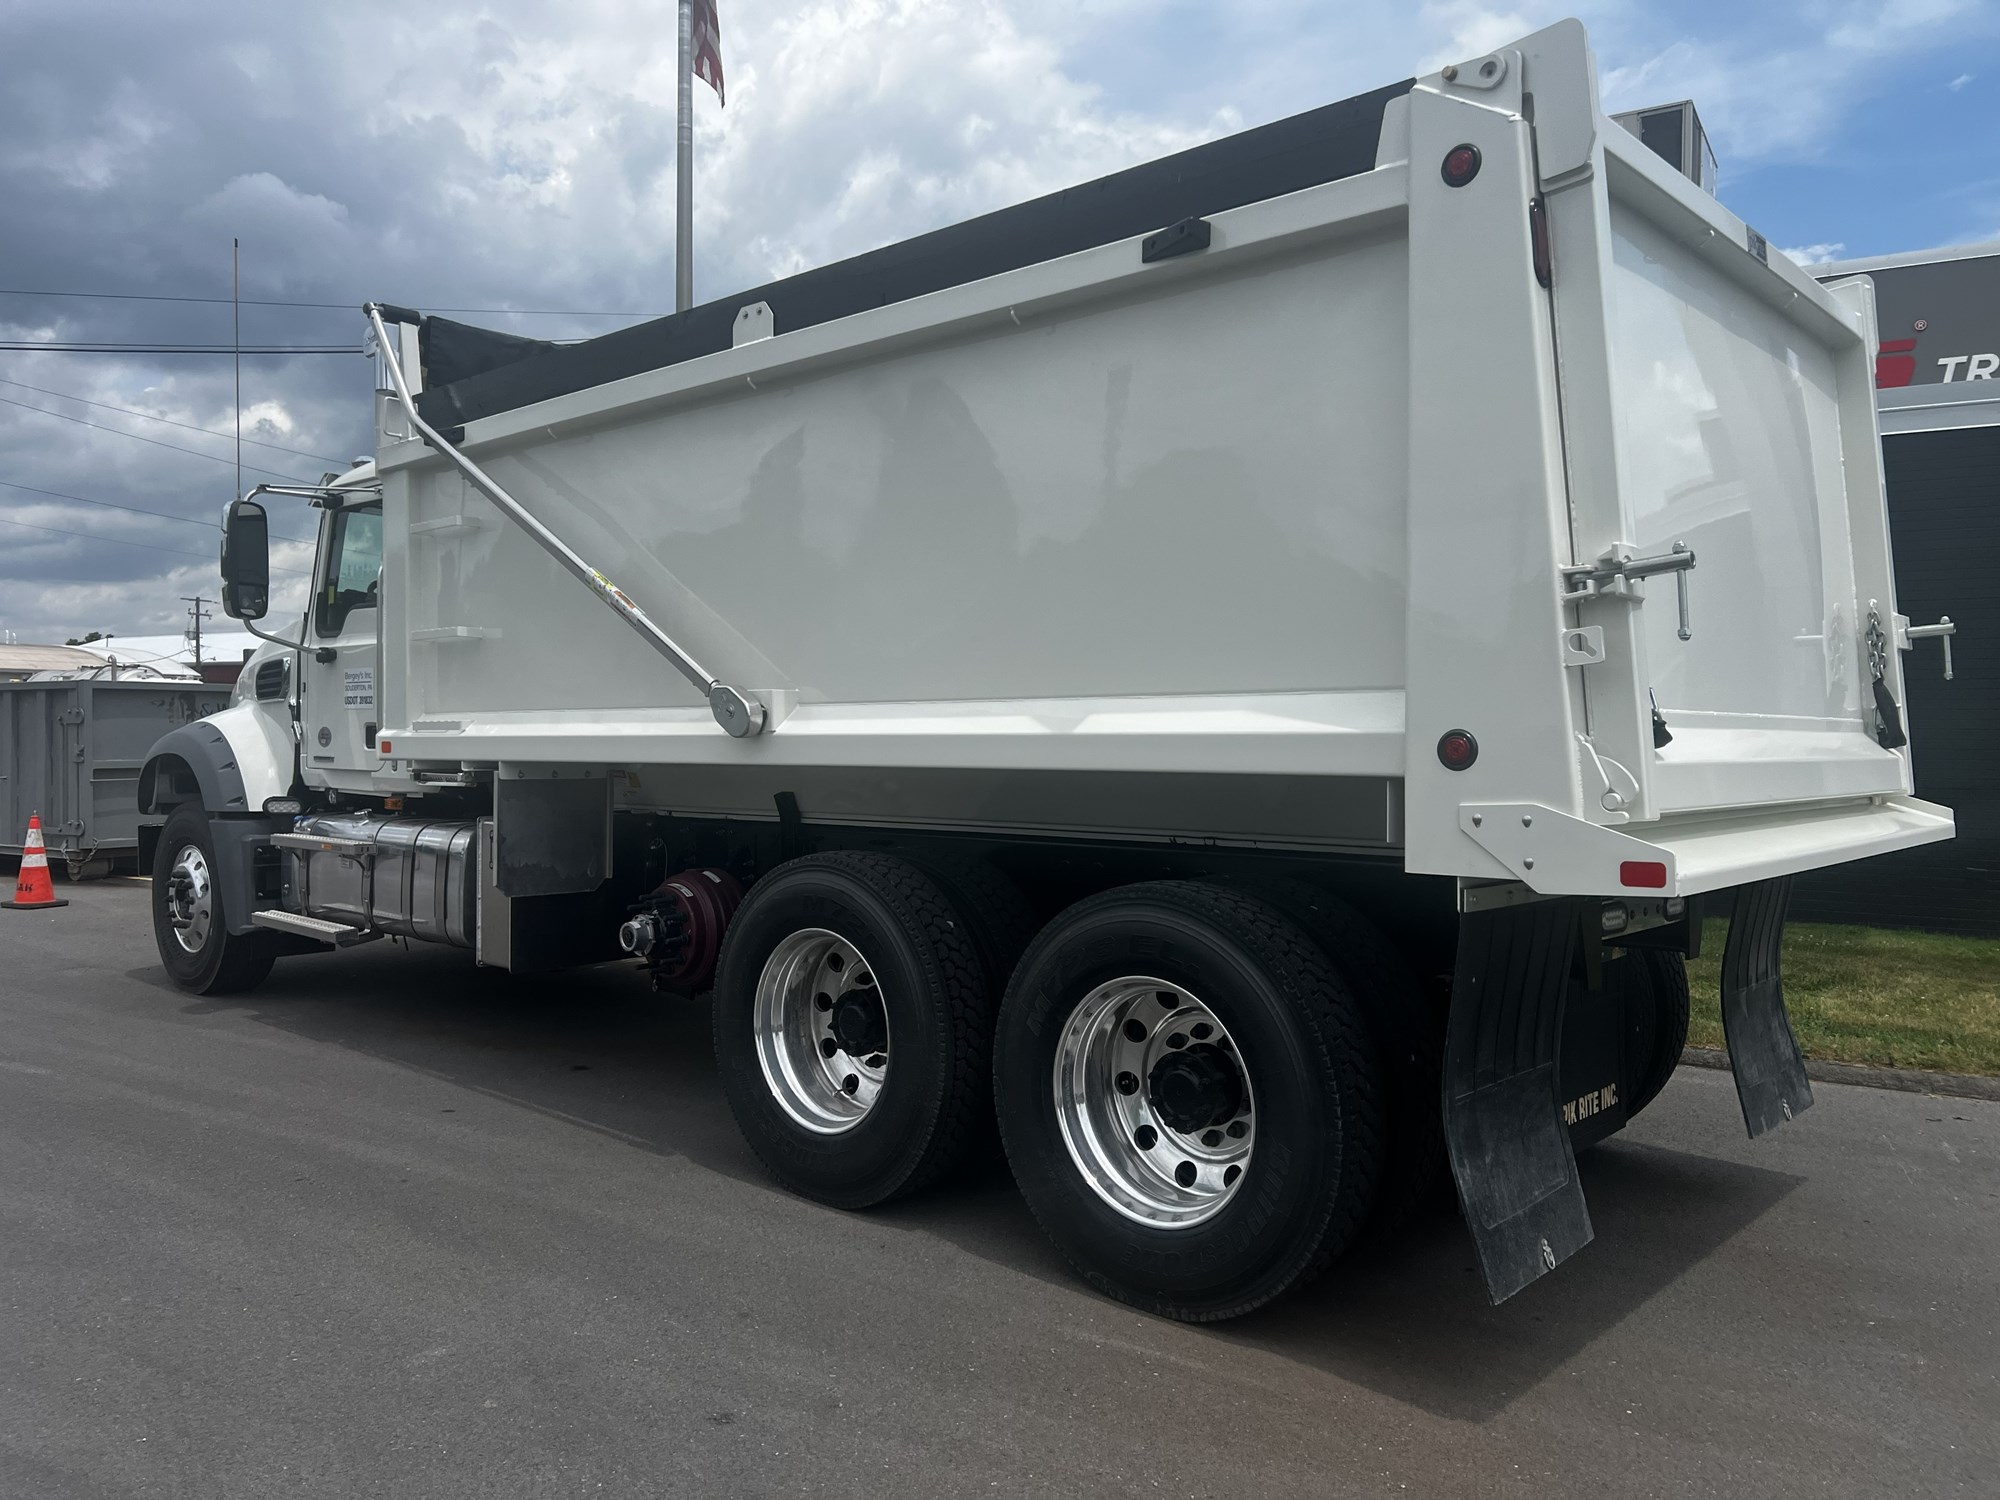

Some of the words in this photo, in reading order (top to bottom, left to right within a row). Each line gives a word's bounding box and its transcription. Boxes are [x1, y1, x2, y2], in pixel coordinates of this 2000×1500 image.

[344, 695, 358, 705] USDOT
[1578, 1091, 1599, 1120] RITE
[1601, 1083, 1618, 1110] INC.
